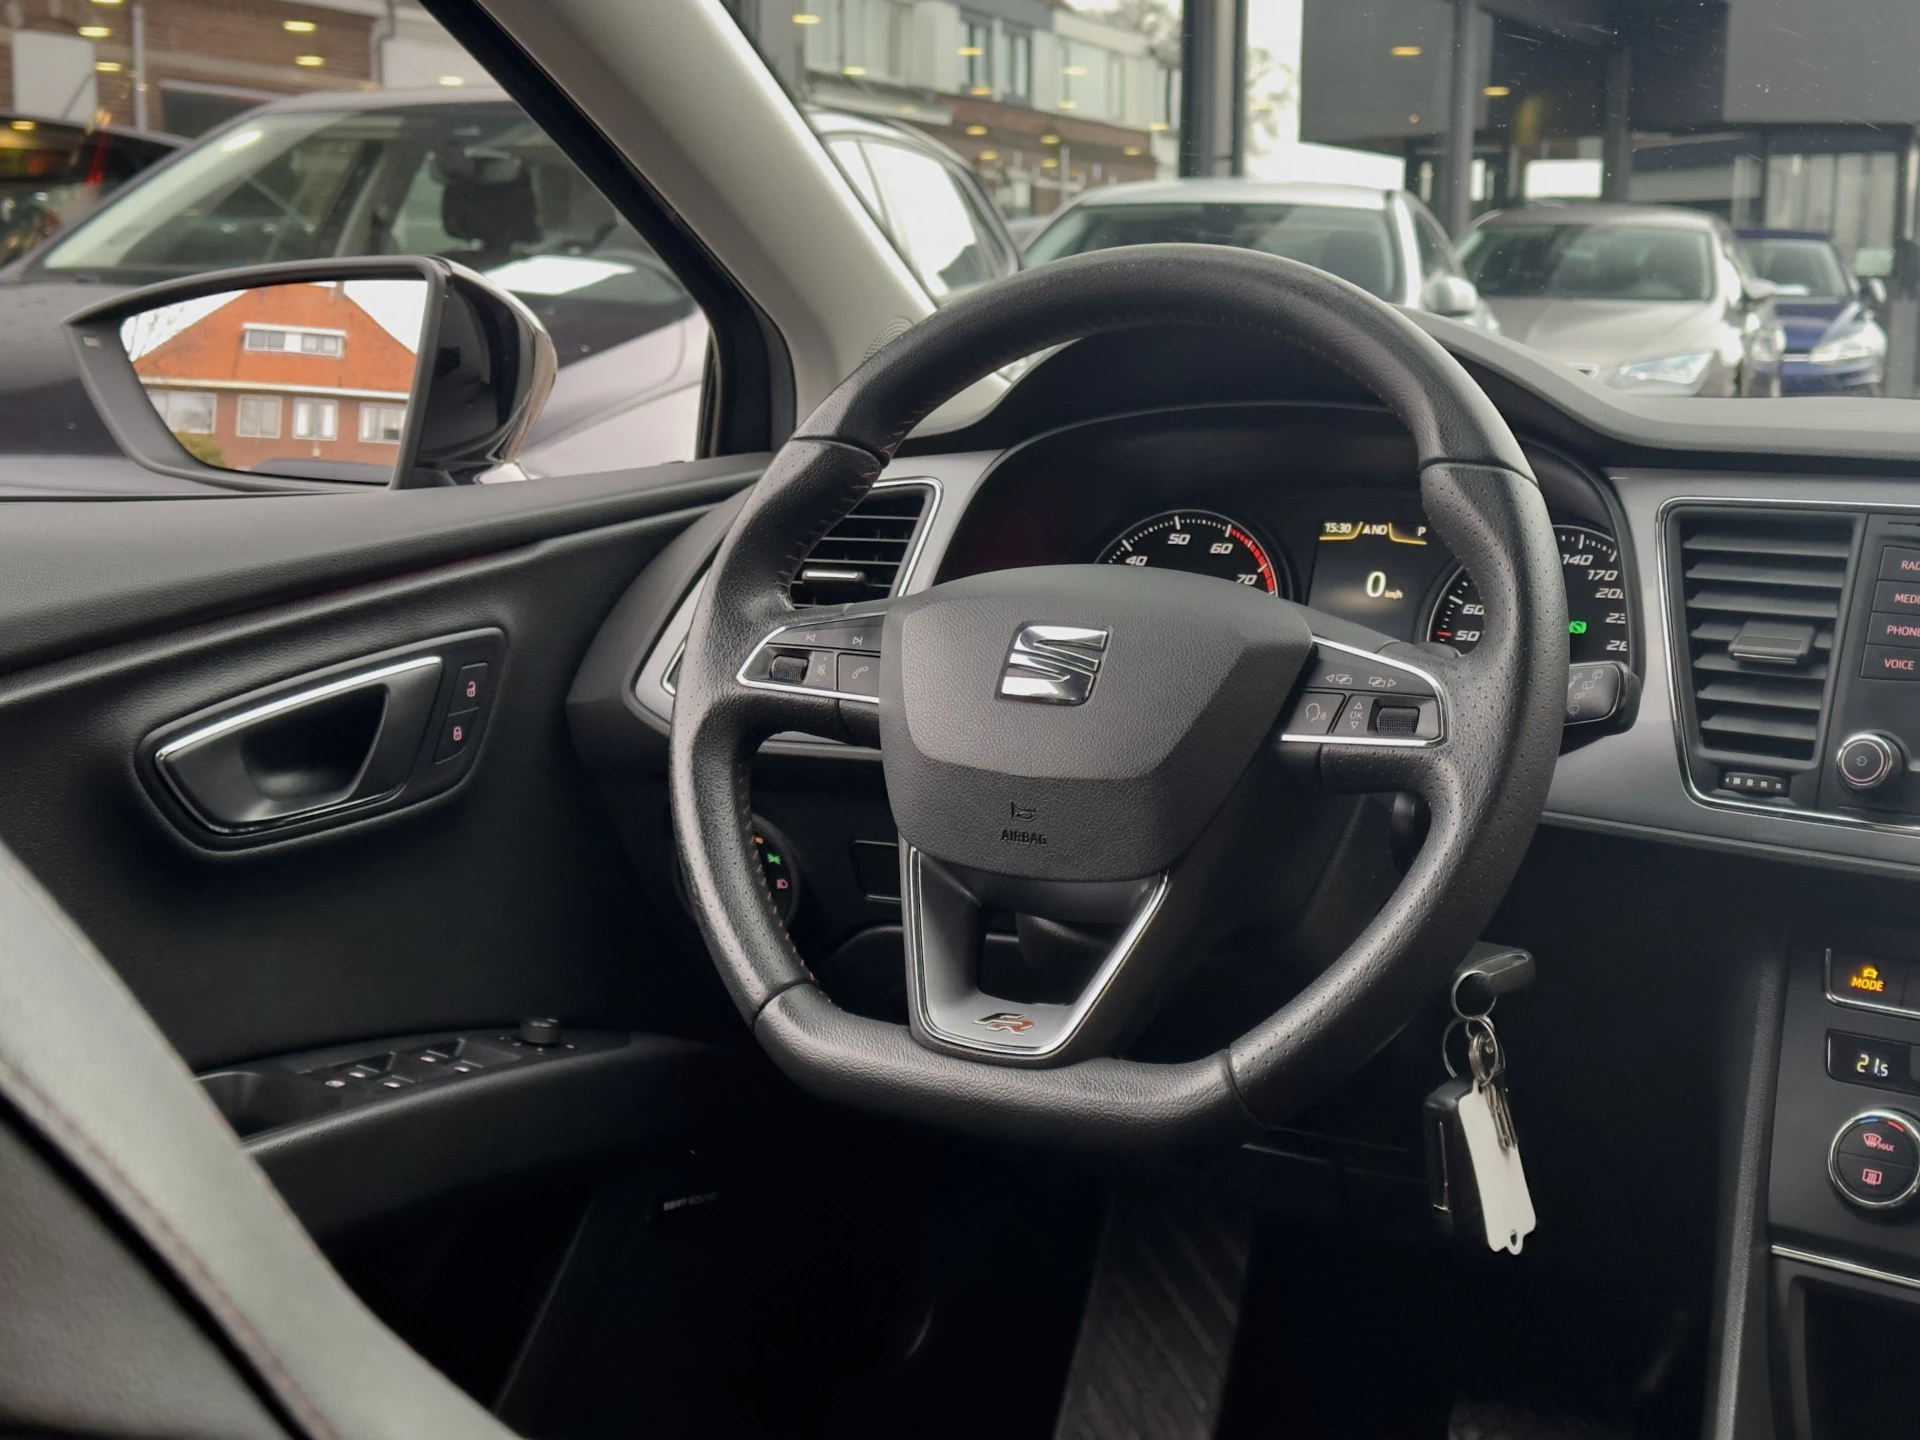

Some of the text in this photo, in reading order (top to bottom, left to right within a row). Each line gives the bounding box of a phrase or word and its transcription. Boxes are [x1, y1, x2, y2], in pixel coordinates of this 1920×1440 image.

[1324, 522, 1352, 534] 15:30
[1417, 526, 1427, 537] P
[1167, 533, 1190, 545] 50
[1210, 543, 1233, 554] 60
[1125, 555, 1148, 566] 40
[1562, 554, 1593, 565] 140
[1236, 574, 1257, 585] 70
[1587, 570, 1618, 581] 170
[1366, 571, 1386, 598] 0
[1462, 604, 1484, 616] 60
[1455, 630, 1480, 641] 50
[1884, 658, 1915, 671] VOICE
[1350, 711, 1363, 720] OK
[1000, 829, 1048, 846] AIRBAG
[1851, 976, 1885, 992] MODE
[1878, 1142, 1895, 1152] MAX
